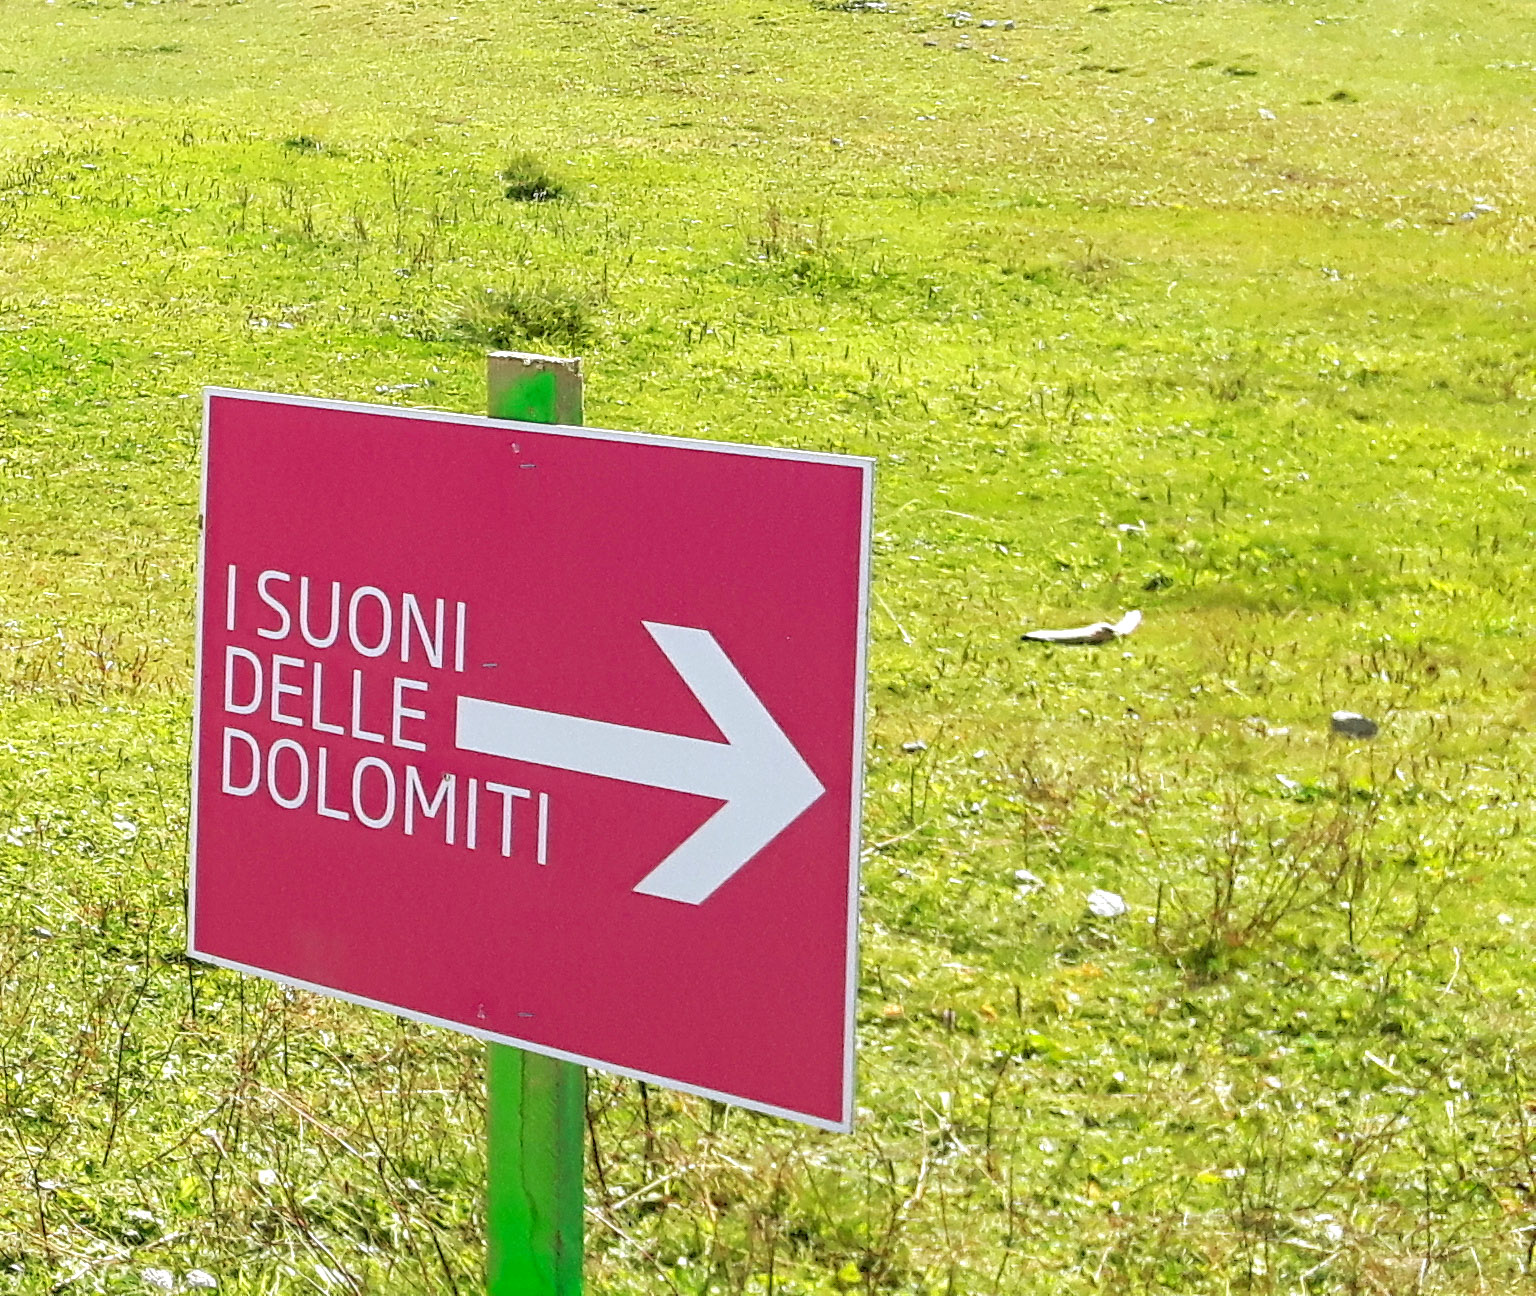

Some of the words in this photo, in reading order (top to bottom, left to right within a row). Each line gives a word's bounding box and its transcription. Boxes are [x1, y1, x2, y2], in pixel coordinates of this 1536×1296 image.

[225, 563, 238, 632] I
[257, 569, 466, 673] SUONI
[224, 645, 429, 752] DELLE
[221, 726, 549, 866] DOLOMITI
